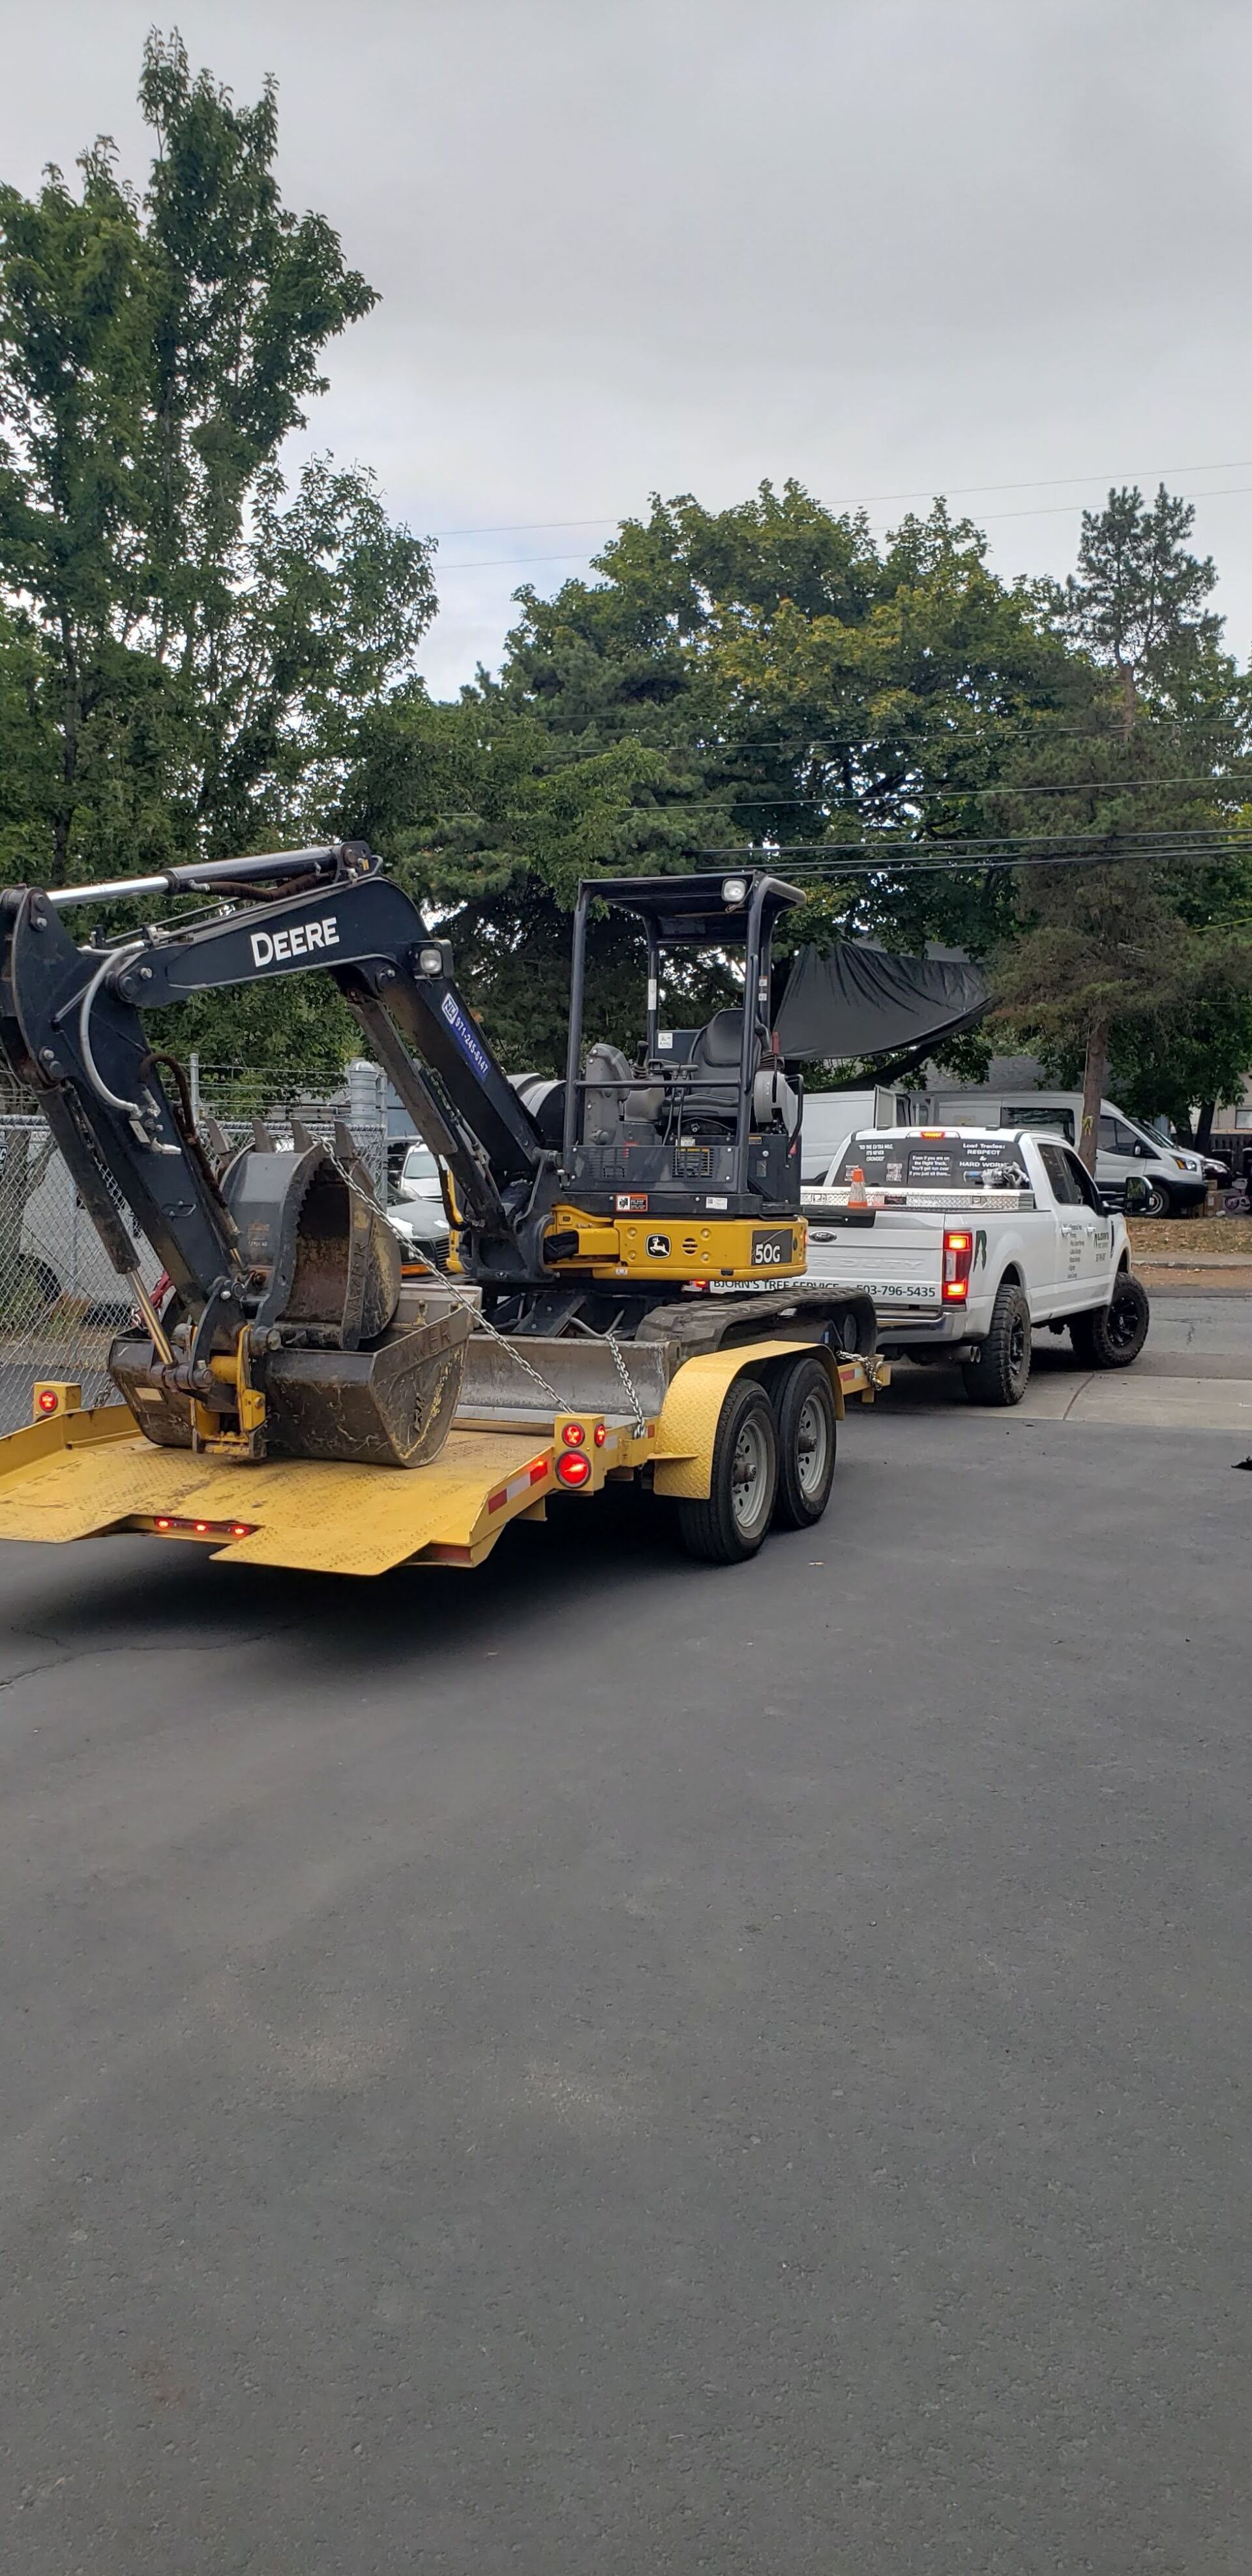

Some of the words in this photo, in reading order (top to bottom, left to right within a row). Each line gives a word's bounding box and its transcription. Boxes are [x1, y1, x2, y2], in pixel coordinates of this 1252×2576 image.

[250, 917, 339, 967] DEERE
[455, 1017, 488, 1073] 971-245-6147
[755, 1243, 781, 1264] 50G
